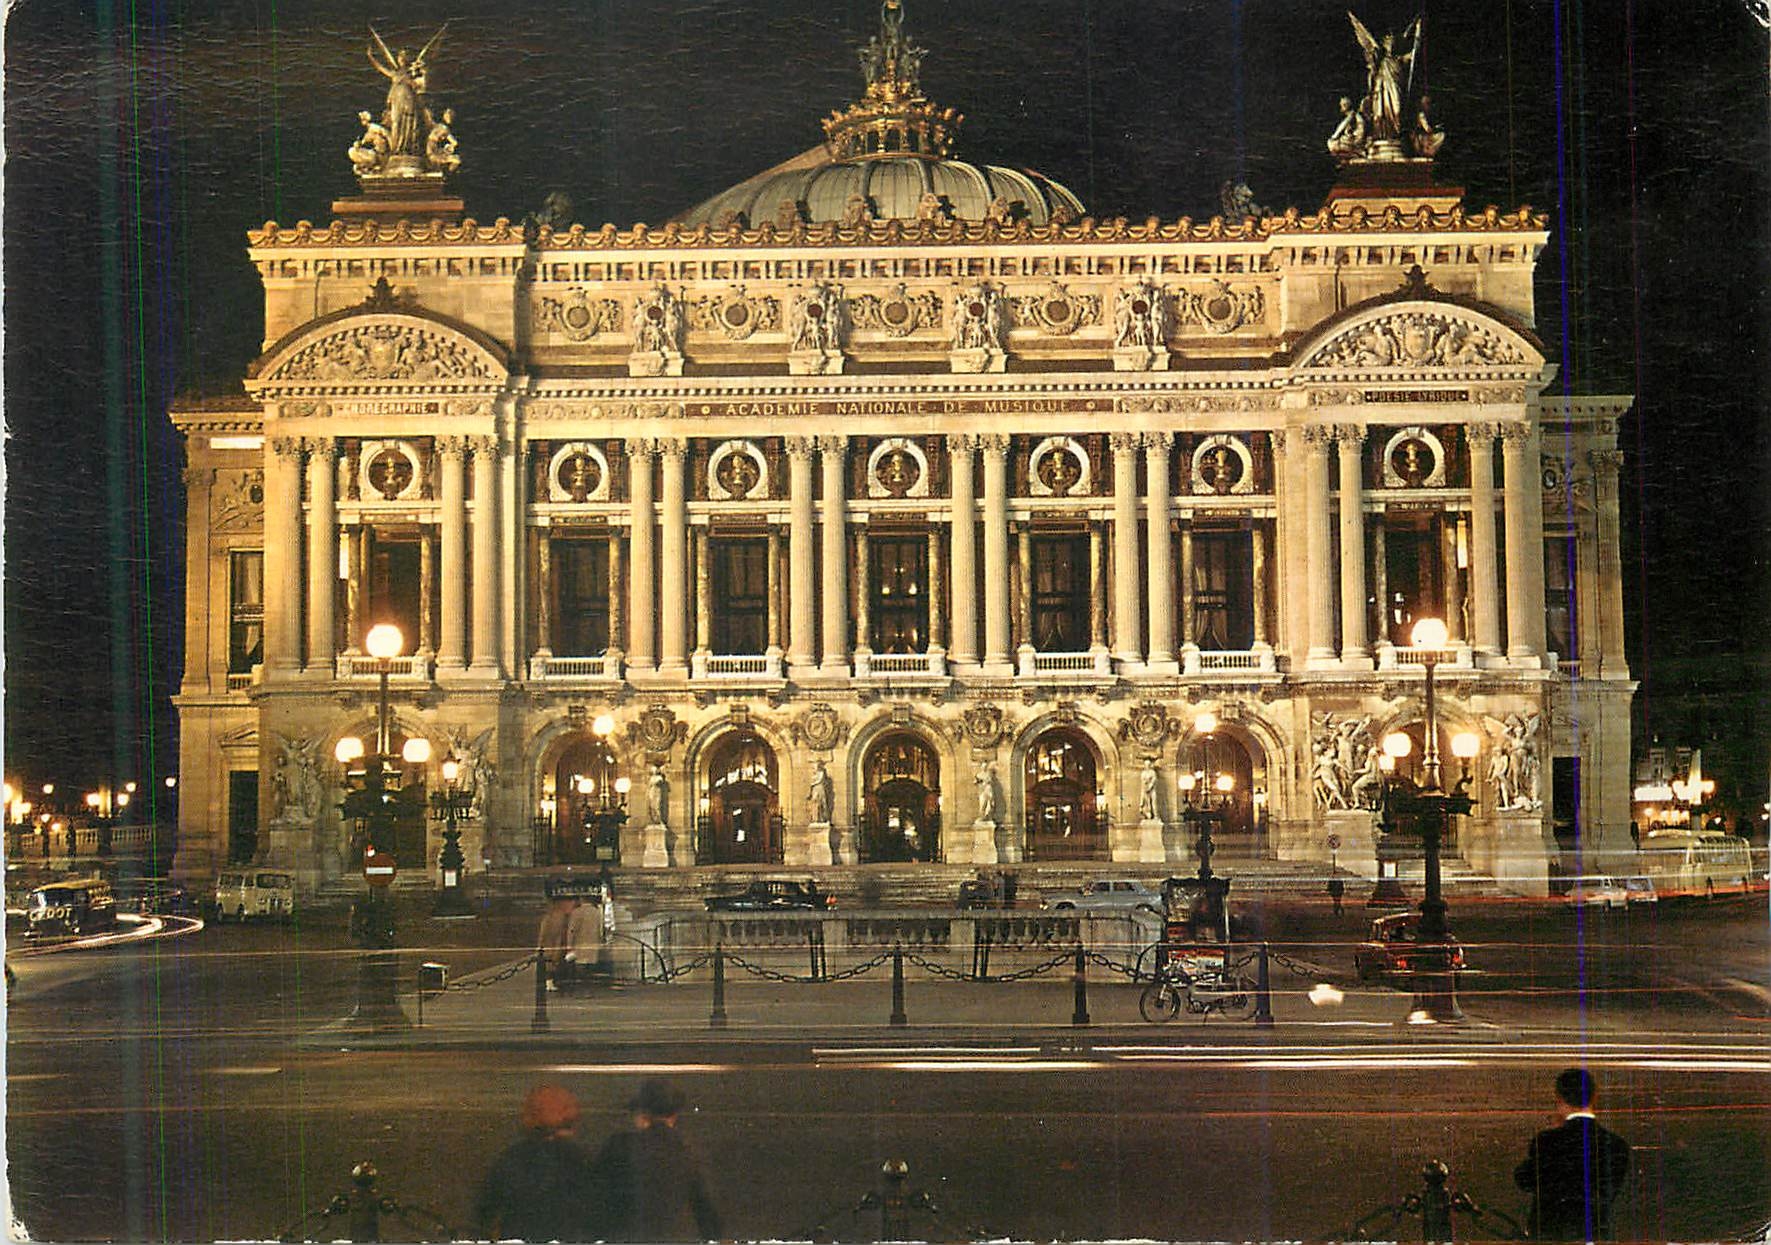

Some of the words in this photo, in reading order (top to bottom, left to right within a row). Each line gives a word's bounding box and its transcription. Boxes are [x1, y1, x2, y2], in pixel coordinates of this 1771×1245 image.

[726, 403, 818, 415] ACADEMIE
[836, 402, 926, 414] NATIONALE
[943, 402, 966, 413] DE
[984, 401, 1070, 413] MUSIQUE
